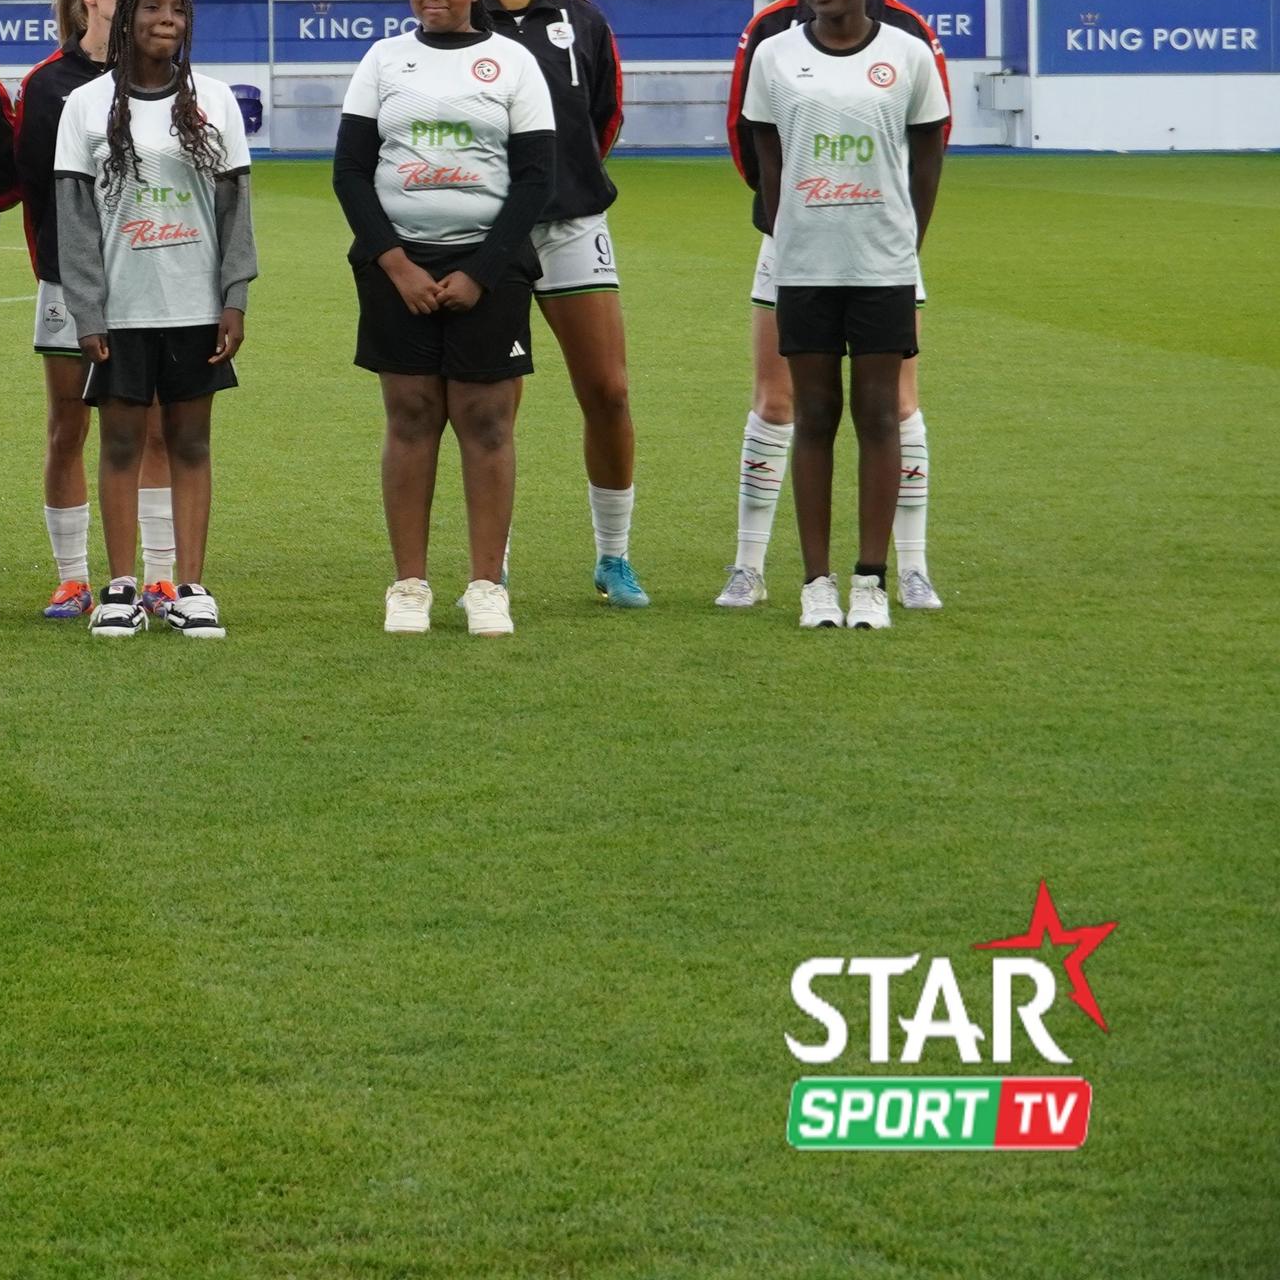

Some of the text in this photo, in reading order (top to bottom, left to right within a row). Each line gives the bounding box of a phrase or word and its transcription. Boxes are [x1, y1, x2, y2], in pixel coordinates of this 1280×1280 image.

[300, 17, 374, 39] KING
[1066, 28, 1258, 51] KING POWER
[396, 161, 481, 189] Ritchie
[795, 176, 883, 204] Ritchie
[120, 219, 201, 246] Ritchie
[594, 233, 611, 266] 9
